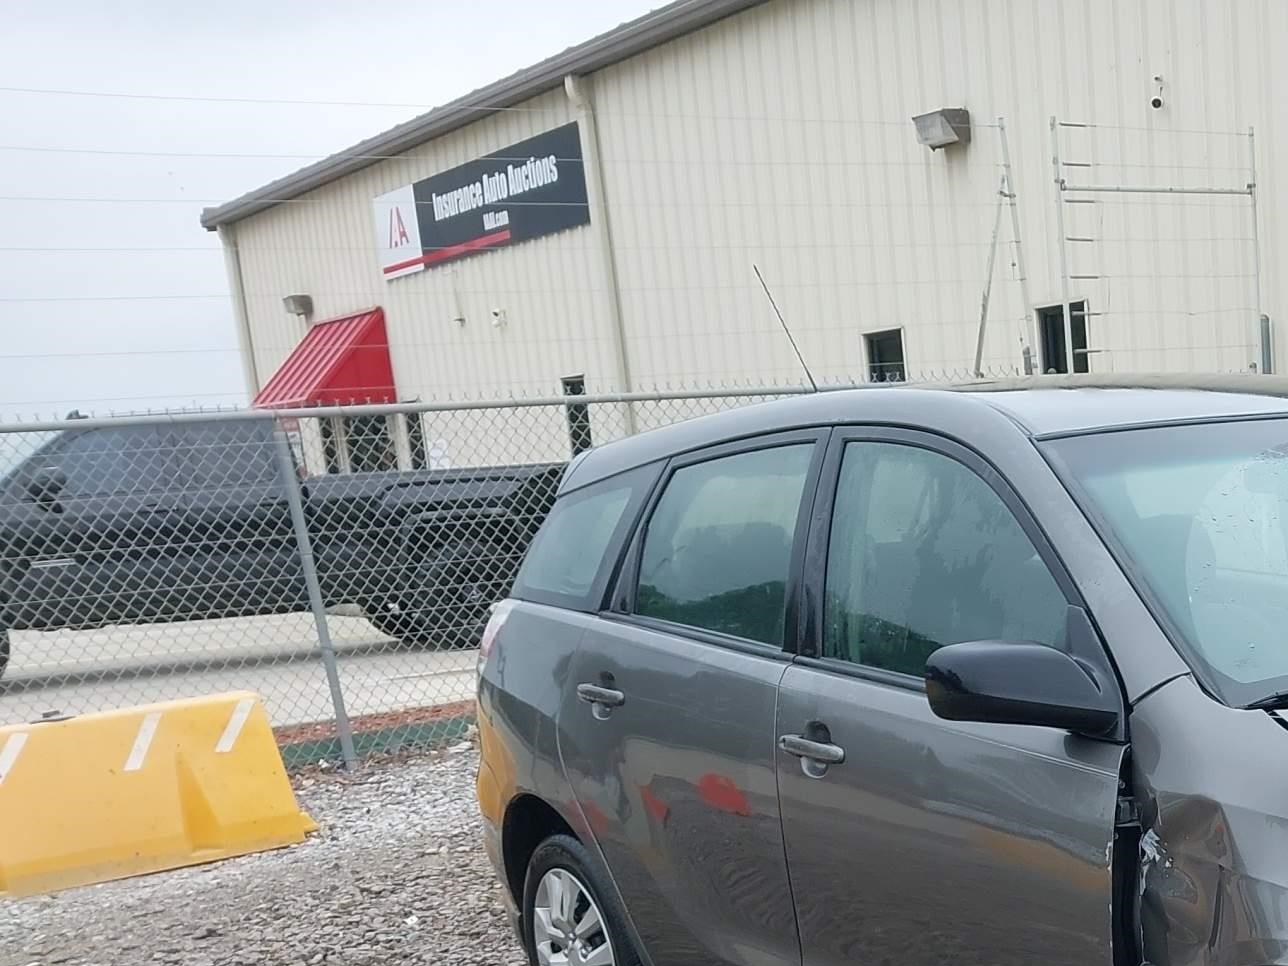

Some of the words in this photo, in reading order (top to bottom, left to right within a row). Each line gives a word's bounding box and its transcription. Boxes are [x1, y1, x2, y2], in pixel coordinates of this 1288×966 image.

[432, 181, 484, 221] Insurance
[483, 171, 508, 205] Auto
[507, 154, 559, 196] Auctions
